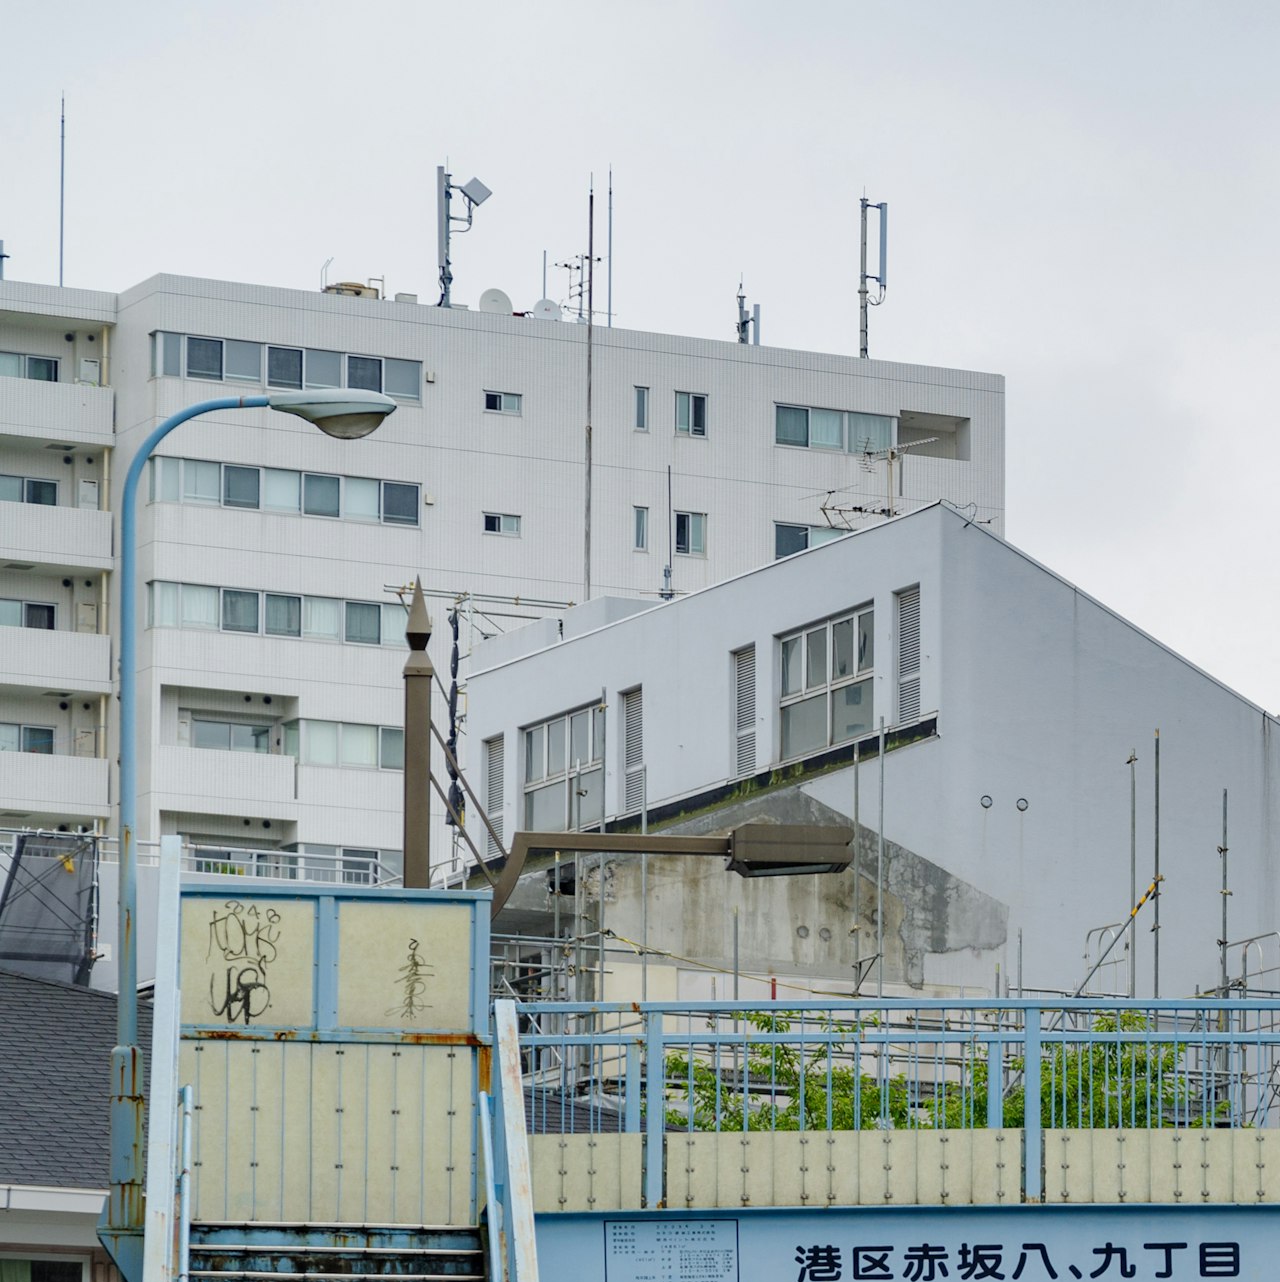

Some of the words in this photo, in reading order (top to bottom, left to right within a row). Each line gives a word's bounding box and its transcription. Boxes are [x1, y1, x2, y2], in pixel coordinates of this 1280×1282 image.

[795, 1242, 1241, 1282] 港区赤坂八、九丁目
